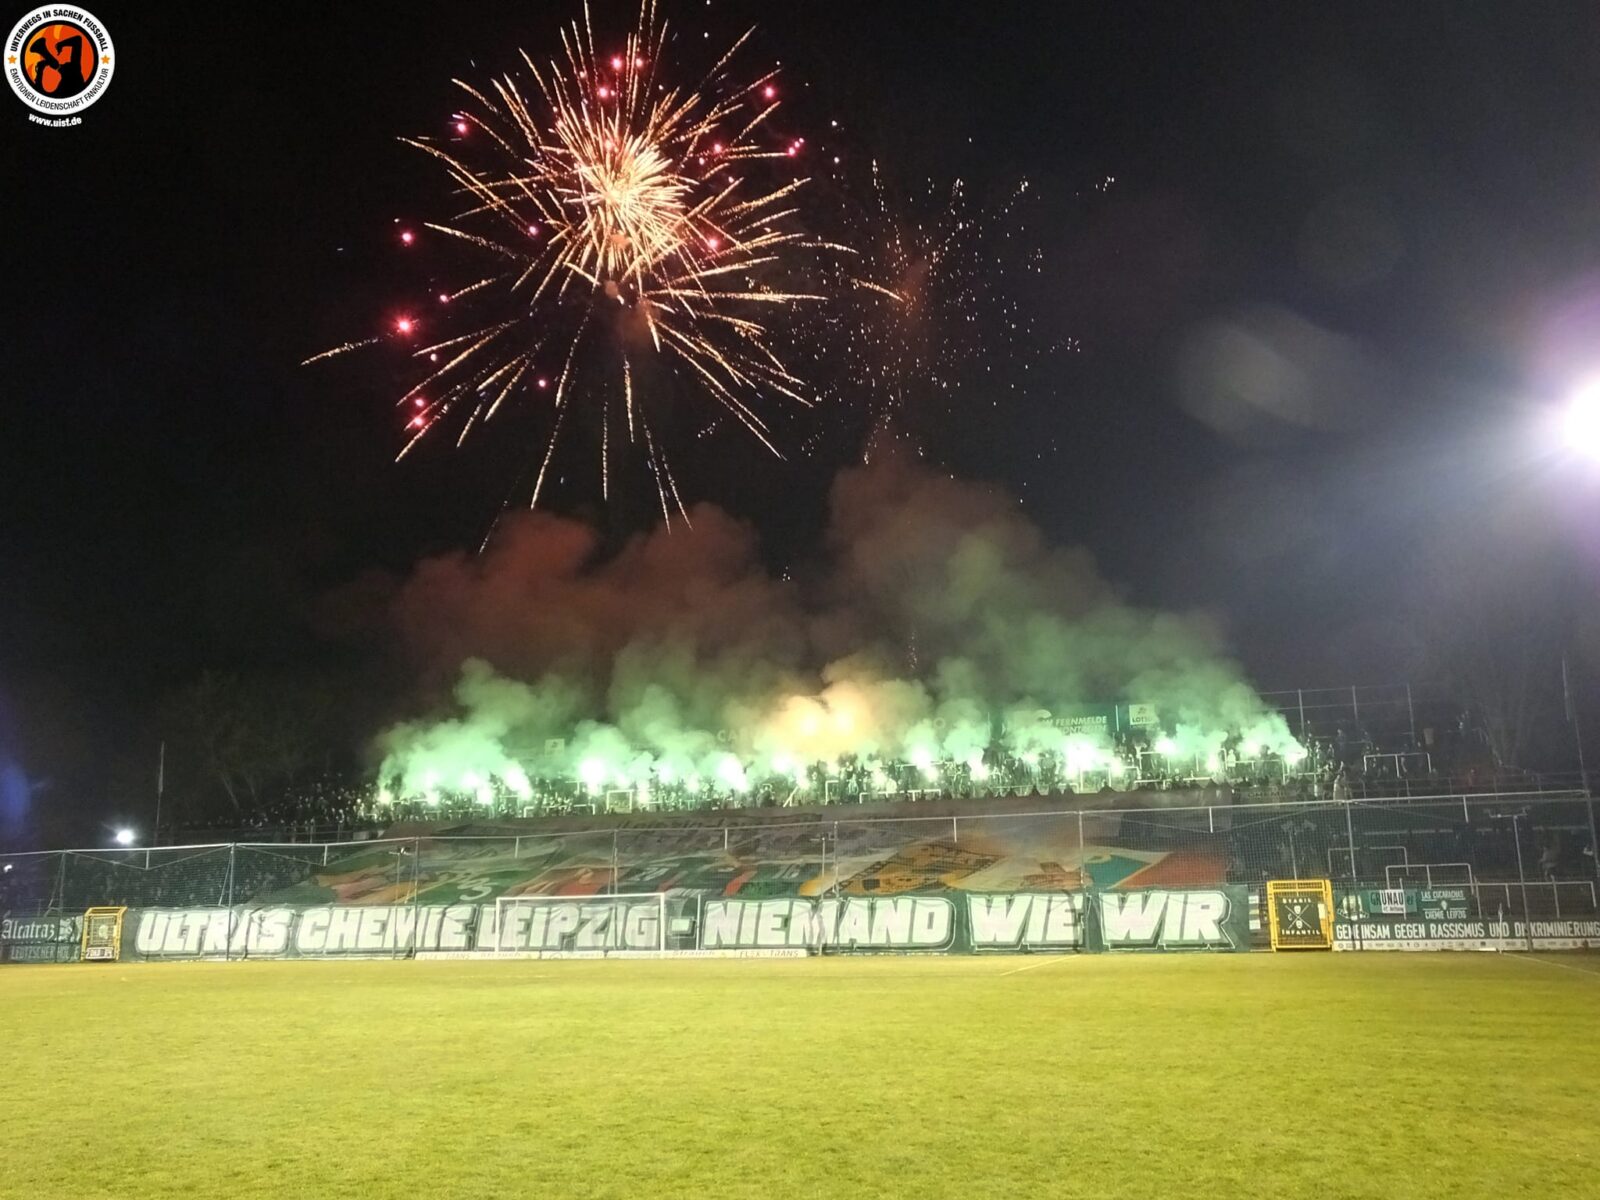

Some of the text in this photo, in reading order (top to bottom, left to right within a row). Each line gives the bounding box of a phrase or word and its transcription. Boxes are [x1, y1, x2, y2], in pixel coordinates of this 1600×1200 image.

[1, 919, 55, 940] Alcatraz
[136, 907, 291, 953] ULTRAS
[297, 905, 475, 952] CHEMIE
[477, 903, 660, 950] LEIPZIG
[704, 897, 953, 948] NIEMAND
[968, 893, 1084, 945] WIE
[1100, 891, 1230, 946] WIR
[1394, 923, 1426, 939] GEGEN
[1430, 922, 1485, 938] RASSISMUS
[1489, 922, 1510, 937] UND
